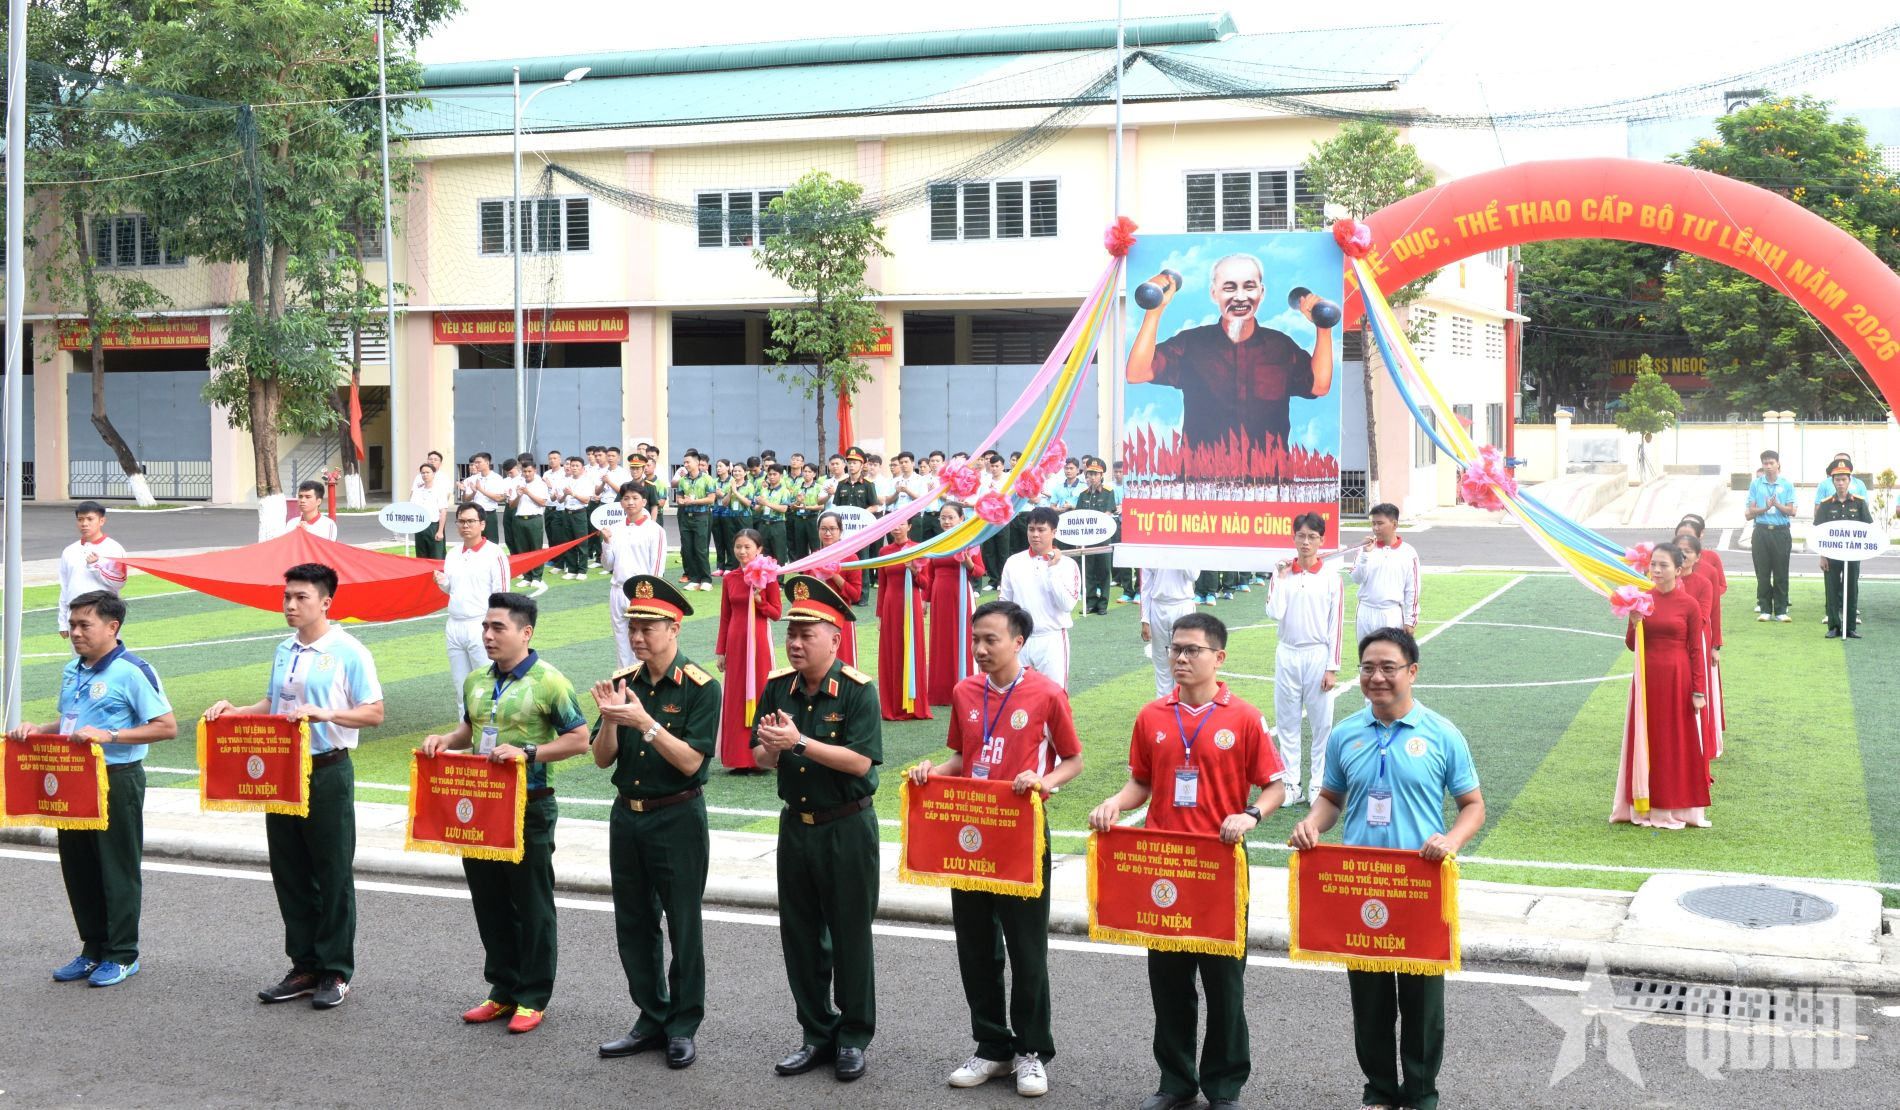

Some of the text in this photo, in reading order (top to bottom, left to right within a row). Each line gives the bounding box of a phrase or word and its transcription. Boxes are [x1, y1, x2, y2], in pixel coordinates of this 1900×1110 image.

[1454, 199, 1503, 238] THỂ
[1506, 199, 1571, 227] THAO
[1581, 194, 1633, 223] CẤP
[1640, 203, 1674, 234] BỘ
[1681, 213, 1717, 242] TƯ
[1718, 226, 1789, 272] LỆNH
[1786, 258, 1849, 310] NĂM
[1842, 303, 1899, 363] 2026
[442, 321, 459, 334] YÊU
[462, 322, 473, 333] XE
[476, 321, 496, 333] NHƯ
[549, 319, 575, 332] XĂNG
[578, 320, 599, 331] NHƯ
[601, 317, 623, 331] MÁU
[1157, 510, 1177, 531] TÔI
[1182, 511, 1217, 533] NGÀY
[1221, 512, 1249, 534] NÀO
[1254, 514, 1291, 535] CŨNG
[1845, 540, 1861, 549] TÂM
[239, 782, 277, 797] LƯU NIỆM
[445, 826, 484, 843] LƯU NIỆM
[1137, 840, 1147, 853] BỘ
[1150, 842, 1161, 852] TƯ
[1161, 842, 1183, 855] LỆNH
[944, 857, 995, 875] LƯU NIỆM
[1343, 859, 1405, 874] BỘ TƯ LỆNH 86
[1319, 872, 1332, 882] HỘI
[1334, 874, 1354, 883] THAO
[1373, 877, 1390, 886] DỤC,
[1410, 879, 1431, 887] THAO
[1323, 883, 1337, 893] CẤP
[1339, 886, 1349, 896] BỘ
[1351, 887, 1362, 895] TƯ
[1364, 887, 1385, 897] LỆNH
[1387, 889, 1406, 898] NĂM
[1137, 912, 1192, 932] LƯU NIỆM
[1346, 934, 1405, 953] LƯU NIỆM
